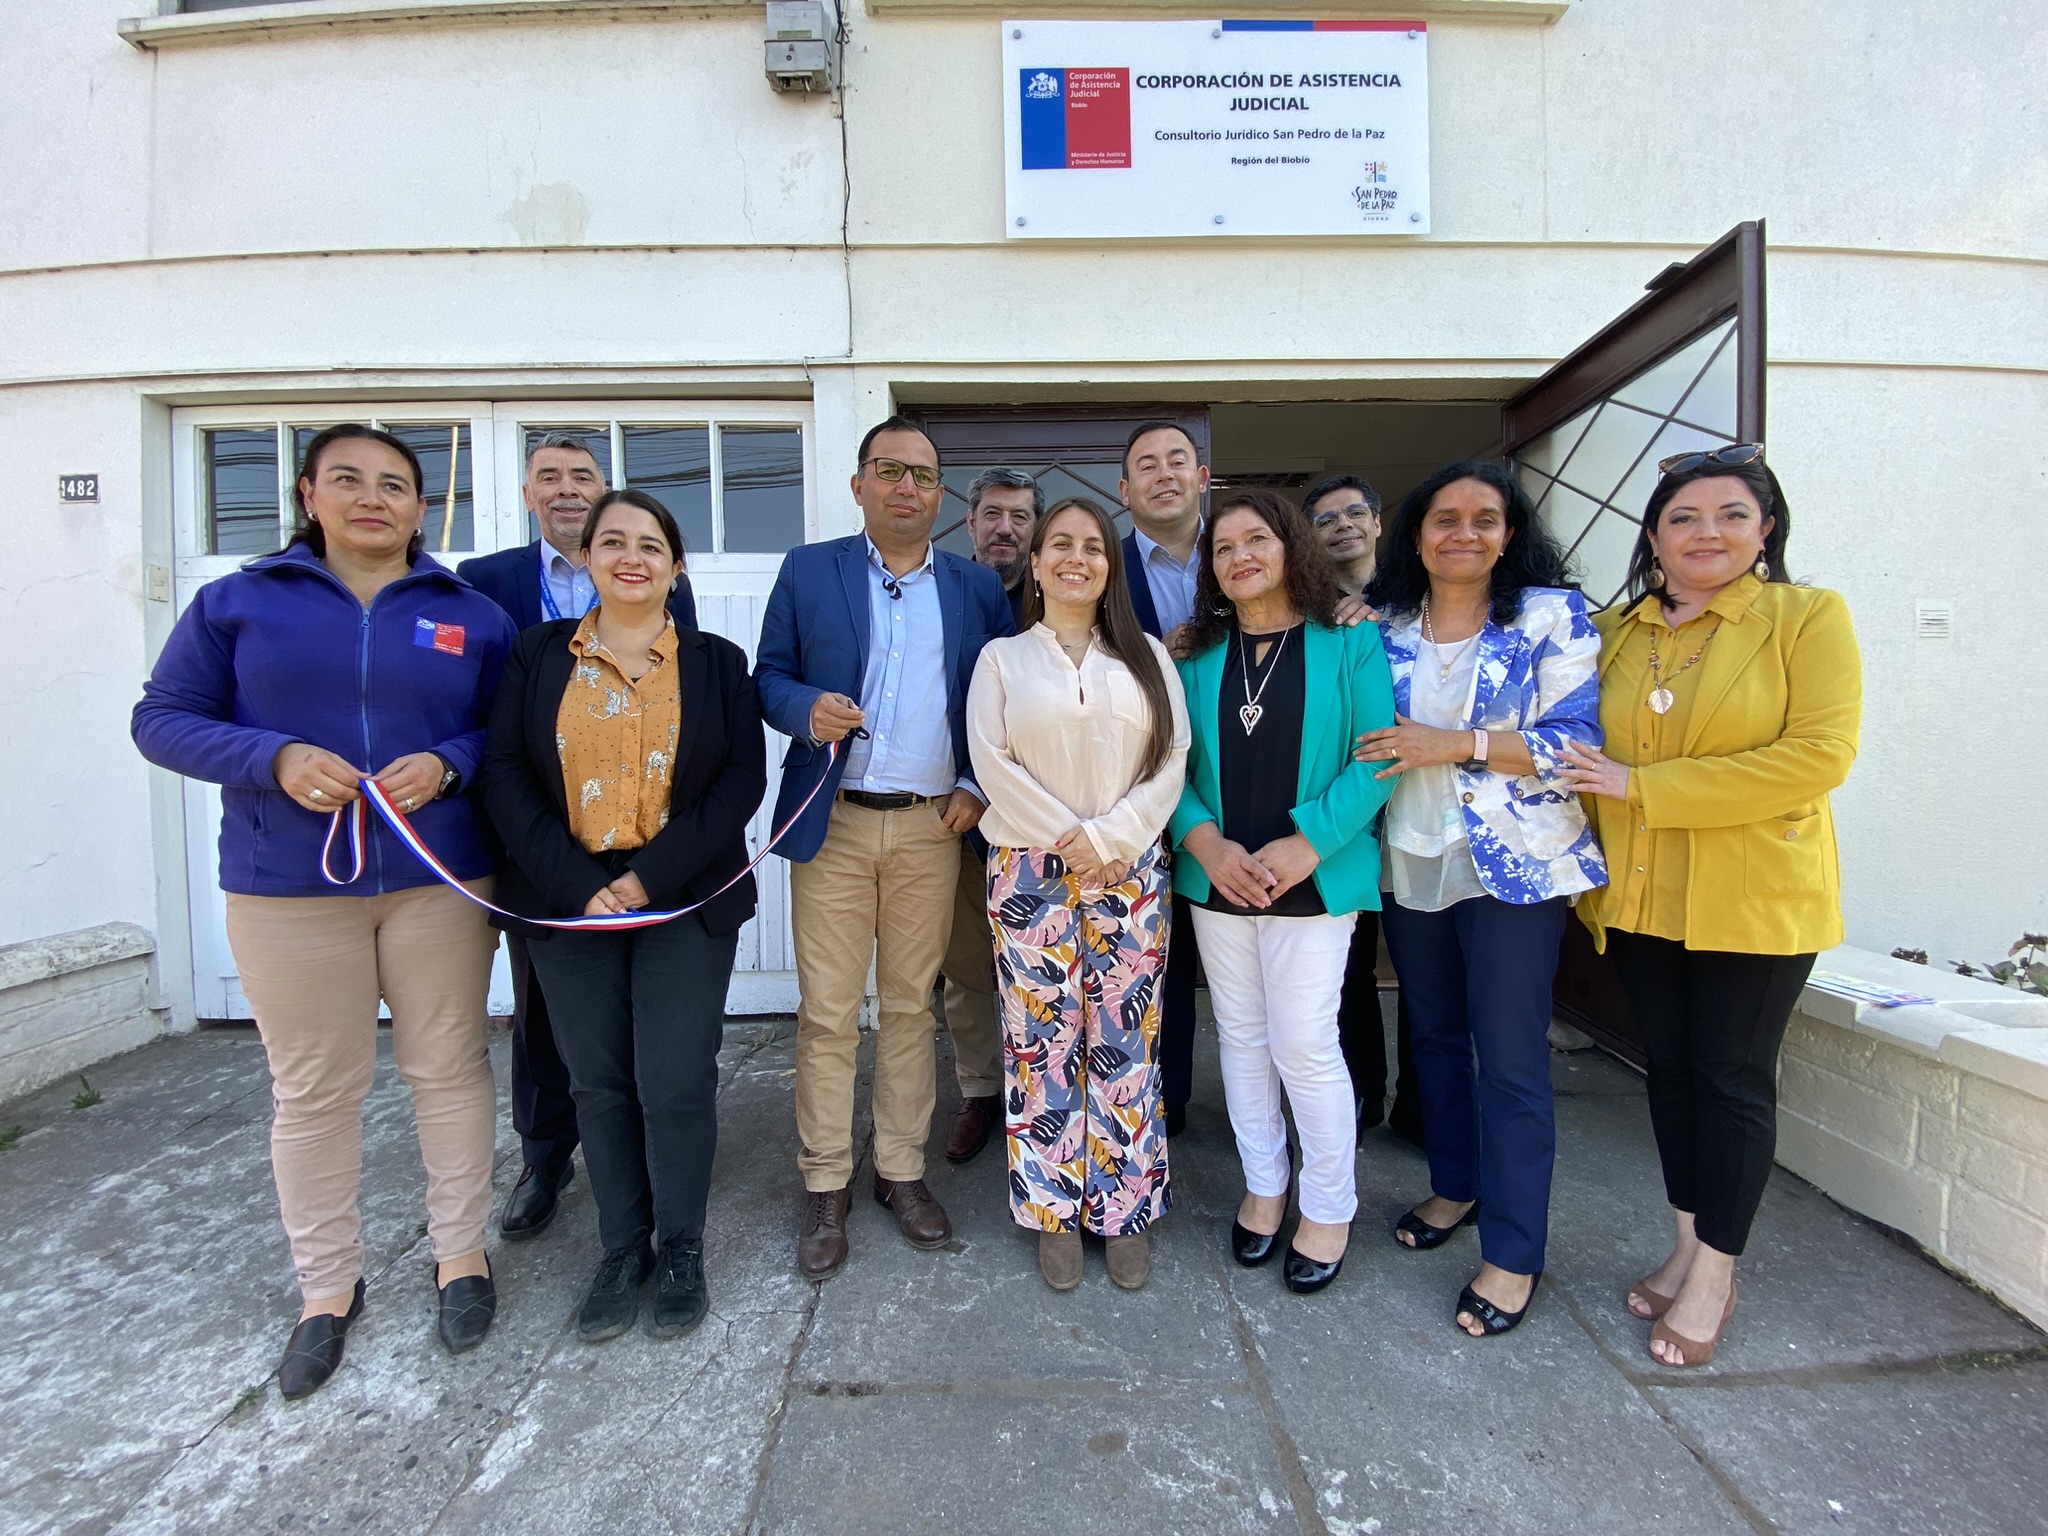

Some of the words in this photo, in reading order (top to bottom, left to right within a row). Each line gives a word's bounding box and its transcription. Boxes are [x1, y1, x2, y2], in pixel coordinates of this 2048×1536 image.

[1069, 72, 1116, 81] Corporación
[1135, 72, 1264, 89] CORPORACIÓN
[1269, 74, 1293, 88] DE
[1298, 74, 1402, 88] ASISTENCIA
[1069, 81, 1080, 89] de
[1081, 81, 1121, 89] Asistencia
[1070, 90, 1100, 98] Judicial
[1229, 97, 1310, 112] JUDICIAL
[1154, 130, 1222, 141] Consultorio
[1225, 129, 1270, 140] Jurídico
[1273, 129, 1294, 140] San
[1297, 128, 1331, 139] Pedro
[1334, 128, 1349, 139] de
[1352, 128, 1362, 139] la
[1365, 129, 1386, 139] Paz
[1231, 156, 1263, 167] Región
[1265, 156, 1279, 164] del
[1281, 156, 1311, 164] Biobío
[61, 479, 95, 497] 1482
